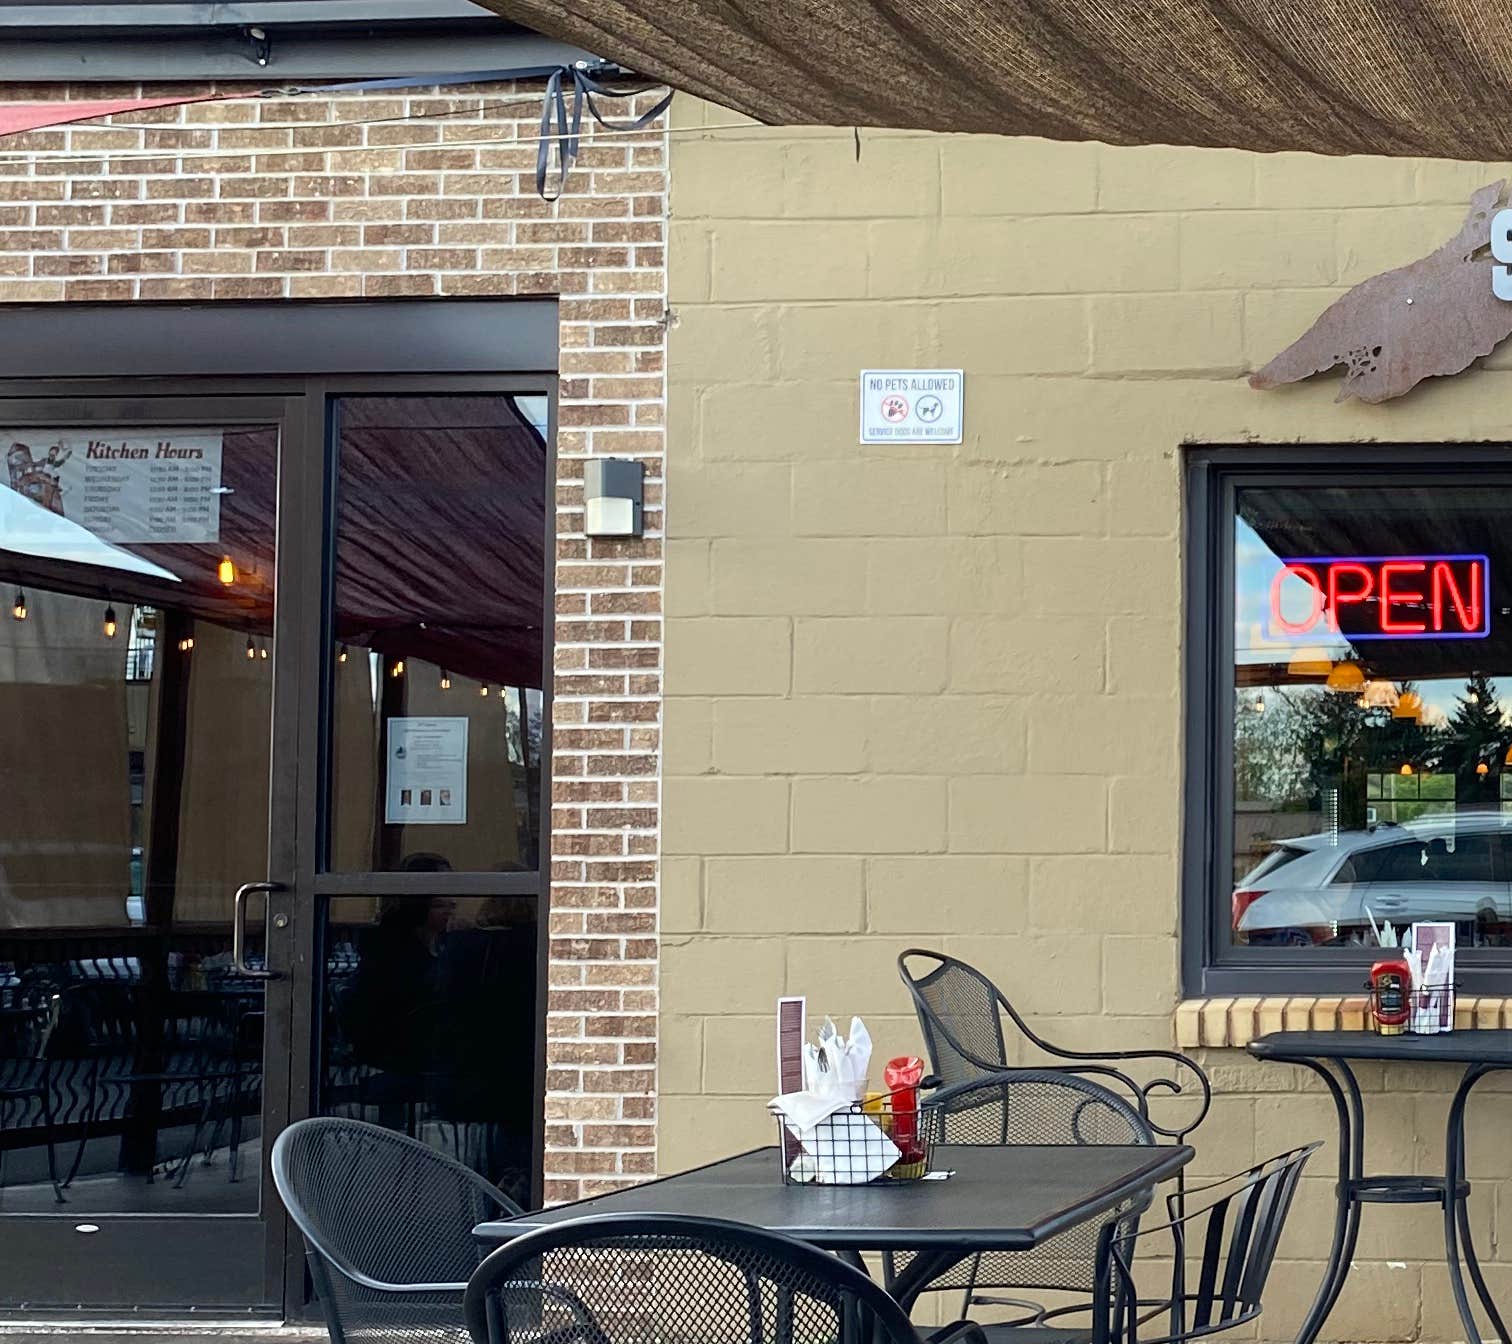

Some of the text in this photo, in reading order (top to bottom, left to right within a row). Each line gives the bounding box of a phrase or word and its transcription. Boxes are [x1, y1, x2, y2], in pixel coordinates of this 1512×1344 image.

[870, 378, 955, 391] NO PETS ALLOWED
[86, 441, 203, 460] Kitchen Hours
[1270, 561, 1480, 633] OPEN
